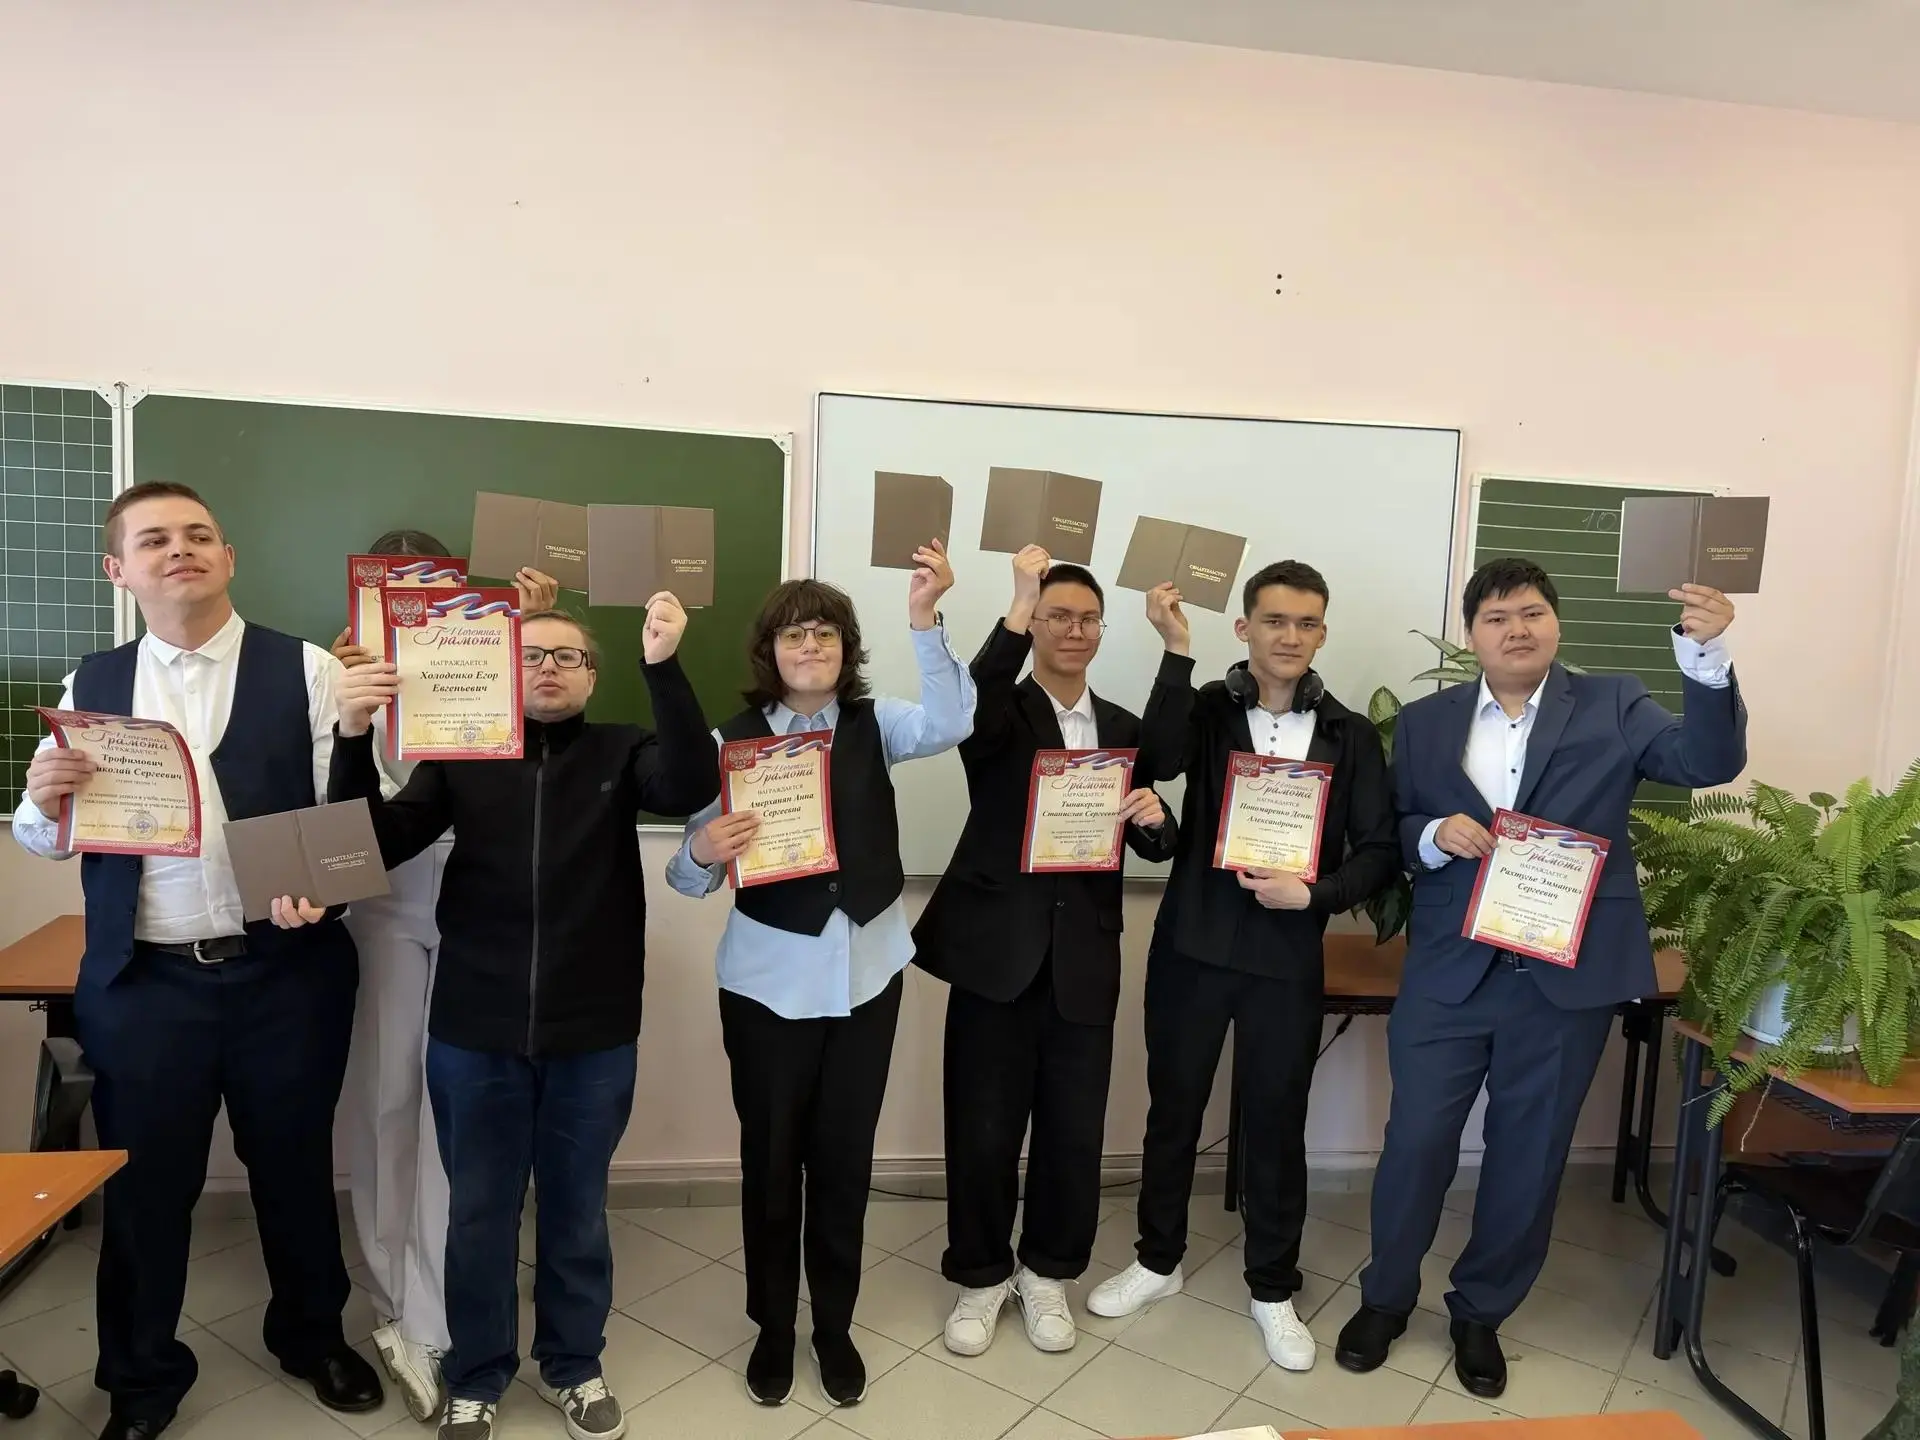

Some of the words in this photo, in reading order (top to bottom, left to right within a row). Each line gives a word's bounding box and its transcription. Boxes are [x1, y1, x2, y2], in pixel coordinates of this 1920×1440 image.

[545, 544, 587, 556] СВИДЕТЕЛЬСТВО
[414, 626, 501, 650] Грамота
[420, 671, 473, 680] Холоденко
[476, 671, 498, 681] Егор
[432, 684, 487, 692] Евгеньевич
[81, 729, 171, 751] Грамота
[102, 754, 163, 767] Трофимович
[96, 766, 131, 776] иколай
[134, 767, 182, 780] Сергеевич
[743, 765, 814, 786] Грамота
[1051, 774, 1116, 793] Грамота
[1246, 778, 1313, 799] Грамота
[749, 796, 792, 809] Амерханян
[794, 793, 814, 802] Анна
[763, 806, 802, 818] Сергеевна
[1239, 802, 1290, 816] Пономаренко
[1290, 810, 1314, 820] Денис
[1246, 815, 1303, 830] Александрович
[1510, 843, 1585, 873] Грамота
[1517, 882, 1559, 900] Сергеевич
[1538, 876, 1583, 895] Эммануил
